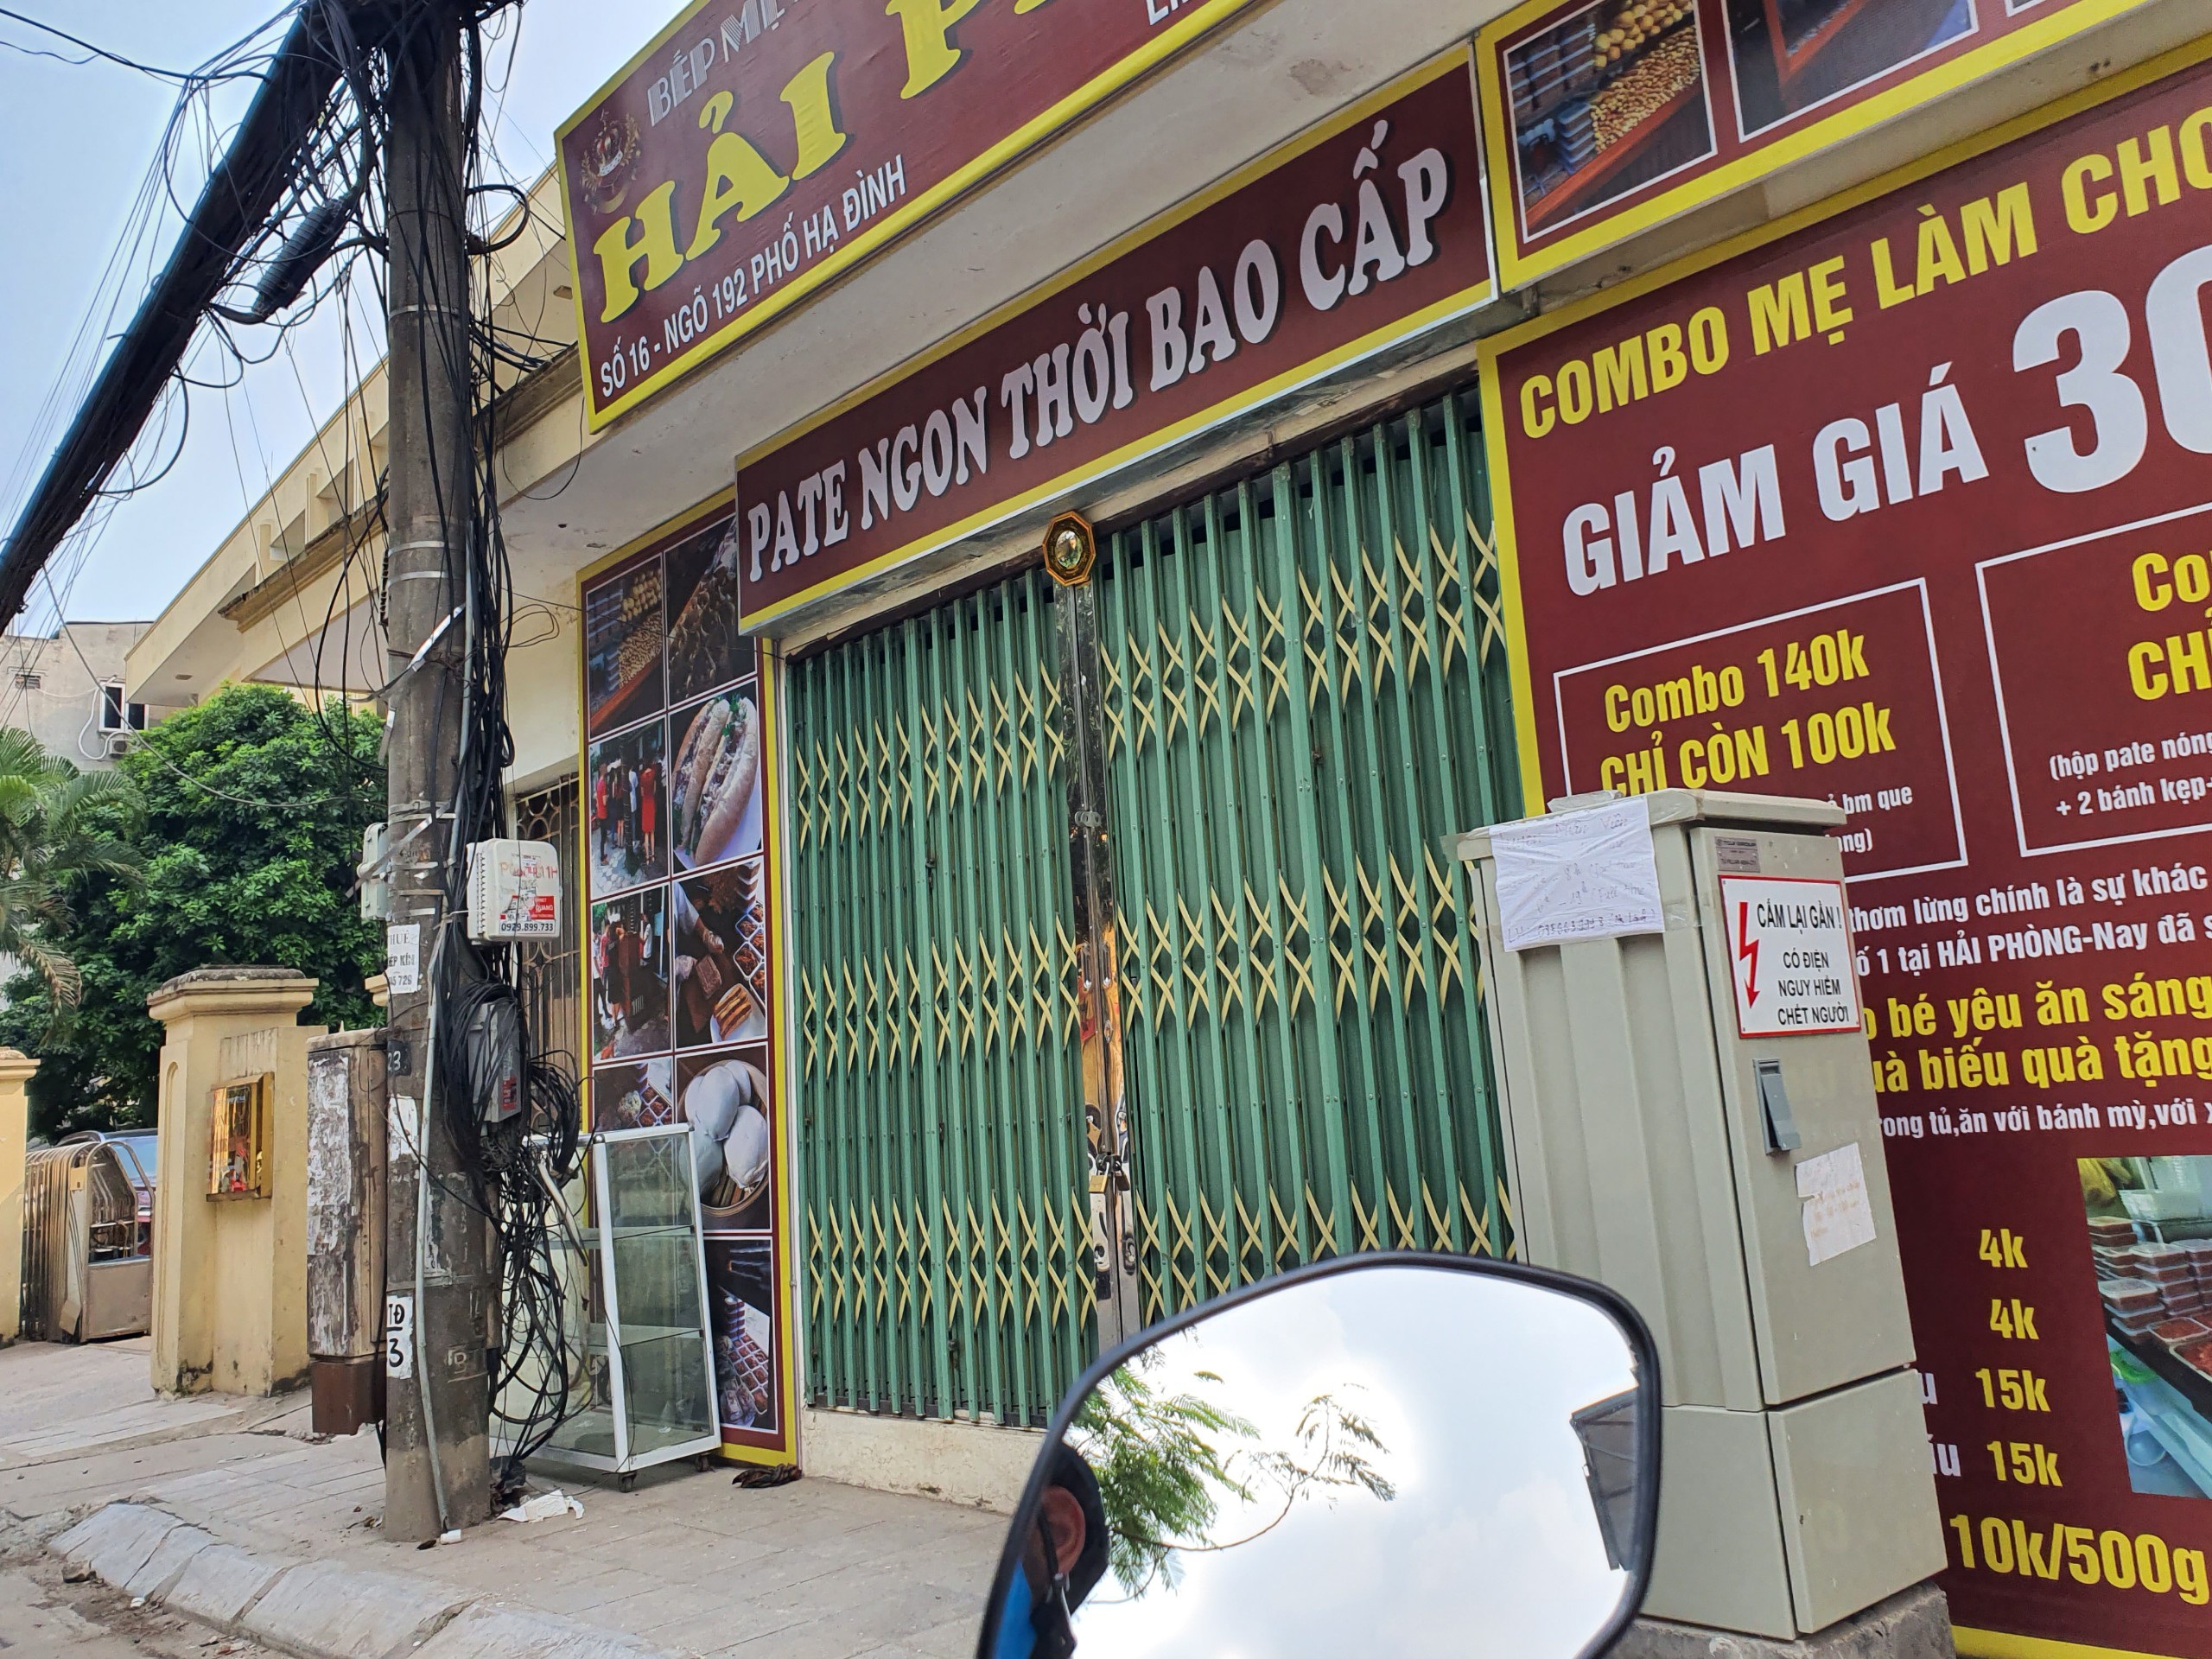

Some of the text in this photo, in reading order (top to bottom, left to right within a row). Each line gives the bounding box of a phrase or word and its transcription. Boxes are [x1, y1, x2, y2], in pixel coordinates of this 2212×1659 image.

[647, 38, 715, 127] BẾP
[593, 51, 847, 323] HẢI
[600, 336, 626, 397] SỐ
[630, 336, 651, 377] 16
[664, 285, 709, 355] NGÕ
[712, 268, 748, 320] 192
[751, 213, 798, 295] PHỐ
[804, 205, 839, 254] HẠ
[842, 155, 907, 232] ĐÌNH
[1520, 307, 1729, 439] COMBO
[1748, 256, 1854, 356] MẸ
[1872, 181, 2037, 309] LÀM
[747, 119, 1447, 582] PATE NGON THỜI BAO CẤP
[1561, 444, 1787, 597] GIẢM
[1812, 361, 1990, 523] GIÁ
[2132, 550, 2212, 612] Co
[1605, 629, 1870, 733] Combo 140k
[2127, 607, 2212, 701] CH
[1600, 702, 1897, 797] CHỈ CÒN 100k
[2049, 751, 2100, 780] (hộp
[2104, 741, 2156, 772] pate
[1841, 793, 1873, 815] bm
[1877, 785, 1913, 810] que
[2056, 800, 2072, 817] +
[2077, 791, 2094, 816] 2
[2098, 782, 2156, 812] bánh
[1757, 898, 1786, 928] CẤM
[1787, 905, 1808, 935] LẠI
[1809, 900, 1835, 929] GẦN
[1913, 896, 1970, 925] lừng
[1975, 882, 2050, 917] chính
[2056, 876, 2085, 906] là
[2091, 873, 2127, 906] sự
[2132, 862, 2209, 897] khác
[1783, 947, 1830, 973] CÓ ĐIỆN
[1876, 948, 1890, 974] 1
[1897, 943, 1931, 976] tại
[1936, 930, 1982, 968] HẢI
[1987, 921, 2148, 962] PHÒNG-Nay
[2157, 912, 2196, 944] đã
[1777, 1001, 1850, 1026] CHẾT NGƯỜI
[1778, 979, 1810, 997] NGUY
[1887, 994, 1937, 1038] bé
[1947, 987, 2023, 1039] yêu
[2036, 980, 2090, 1026] ăn
[2101, 972, 2212, 1020] sáng
[1918, 1037, 2010, 1090] biếu
[2021, 1036, 2104, 1089] quà
[2114, 1031, 2212, 1087] tặng
[1880, 1115, 1924, 1139] ong
[1929, 1106, 1987, 1136] tủ,ăn
[1993, 1105, 2031, 1132] với
[2036, 1103, 2101, 1130] bánh
[2107, 1097, 2197, 1130] mỳ,với
[1979, 1229, 2029, 1268] 4k
[1989, 1299, 2039, 1340] 4k
[389, 1338, 404, 1368] 3
[1975, 1368, 2051, 1413] 15k
[1987, 1440, 2063, 1487] 15k
[1949, 1513, 2210, 1605] 10k/500g
